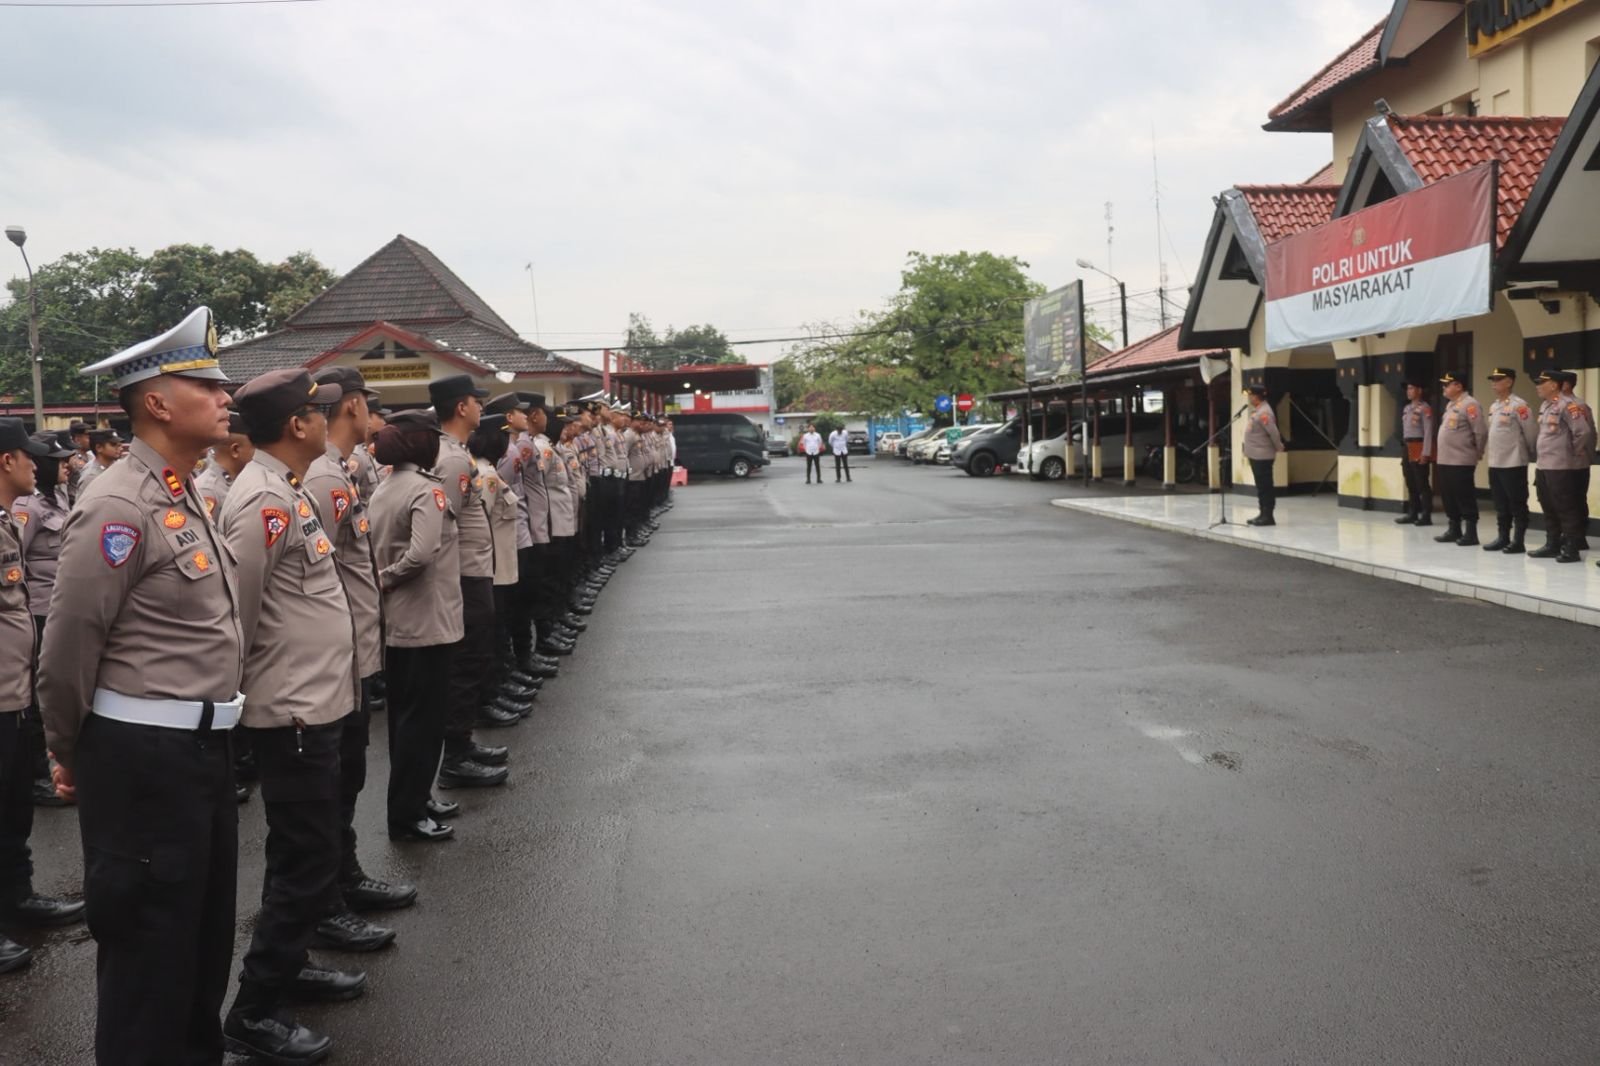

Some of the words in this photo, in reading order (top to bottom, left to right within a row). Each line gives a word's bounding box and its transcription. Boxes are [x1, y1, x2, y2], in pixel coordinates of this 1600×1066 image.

[1468, 0, 1554, 45] POLRE
[1312, 256, 1354, 287] POLRI
[1357, 238, 1413, 274] UNTUK
[1312, 267, 1415, 312] MASYARAKAT
[358, 364, 382, 373] ANTOR
[363, 372, 382, 380] BANG
[176, 529, 200, 547] ADI
